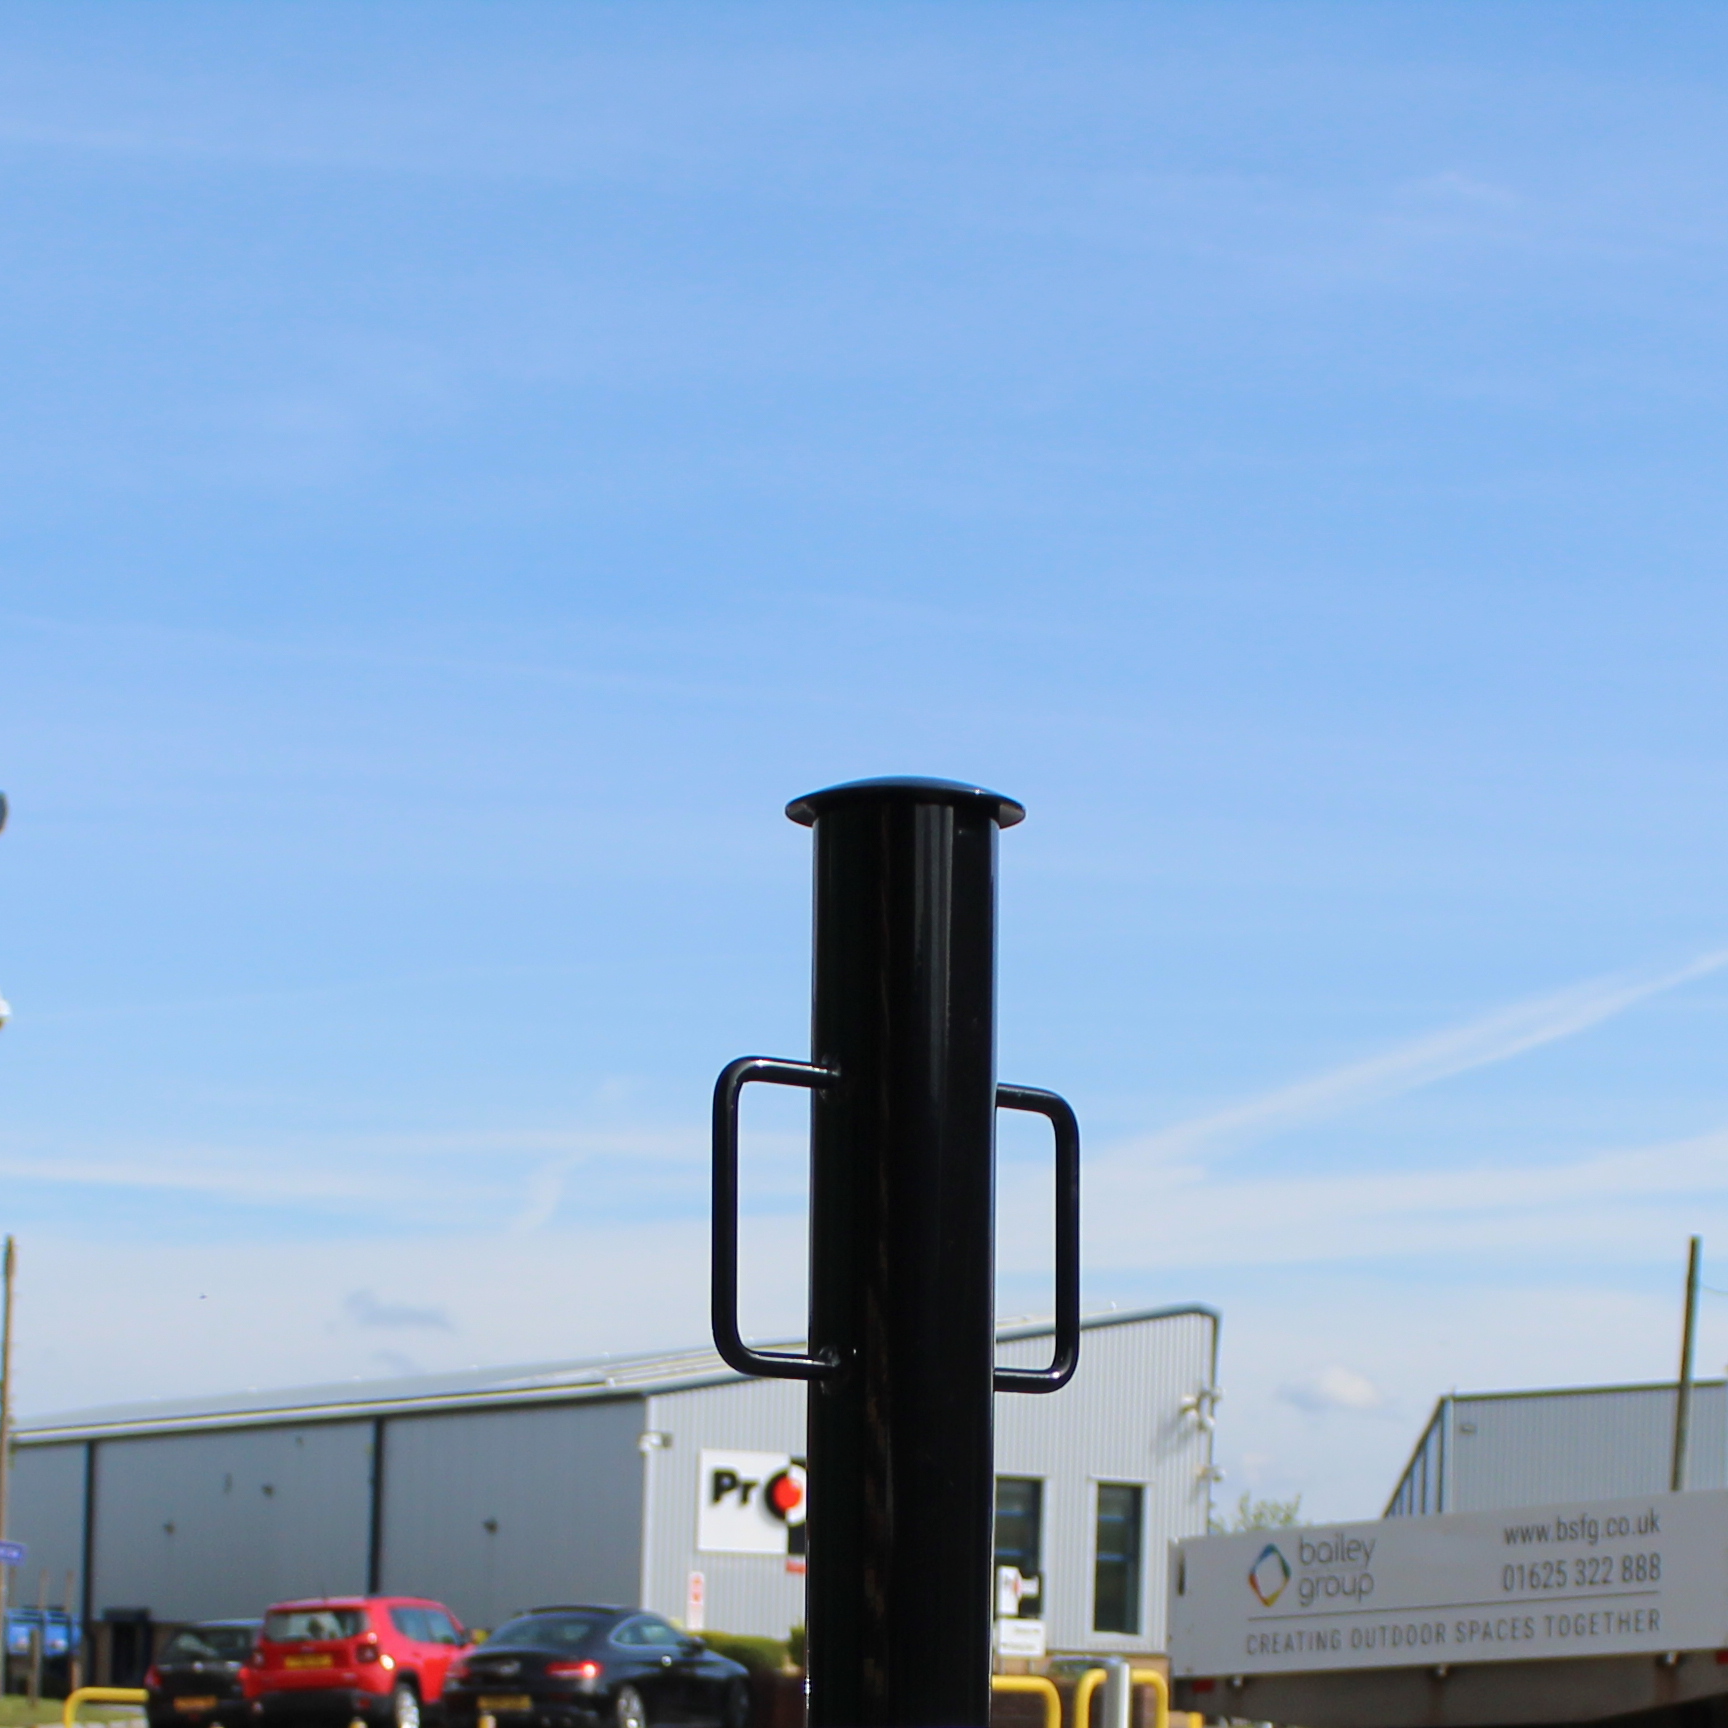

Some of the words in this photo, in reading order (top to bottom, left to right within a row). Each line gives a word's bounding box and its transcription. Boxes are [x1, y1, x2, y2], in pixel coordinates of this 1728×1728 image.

[1503, 1507, 1661, 1546] www.bsfg.co.uk
[1299, 1532, 1376, 1568] bailey
[1298, 1572, 1374, 1608] group
[1502, 1559, 1568, 1592] 01625
[1573, 1556, 1614, 1586] 322
[1621, 1552, 1662, 1584] 888
[1245, 1628, 1342, 1656] CREATING
[1351, 1622, 1447, 1650] OUTDOOR
[1455, 1616, 1536, 1644] SPACES
[1543, 1608, 1661, 1638] TOGETHER
